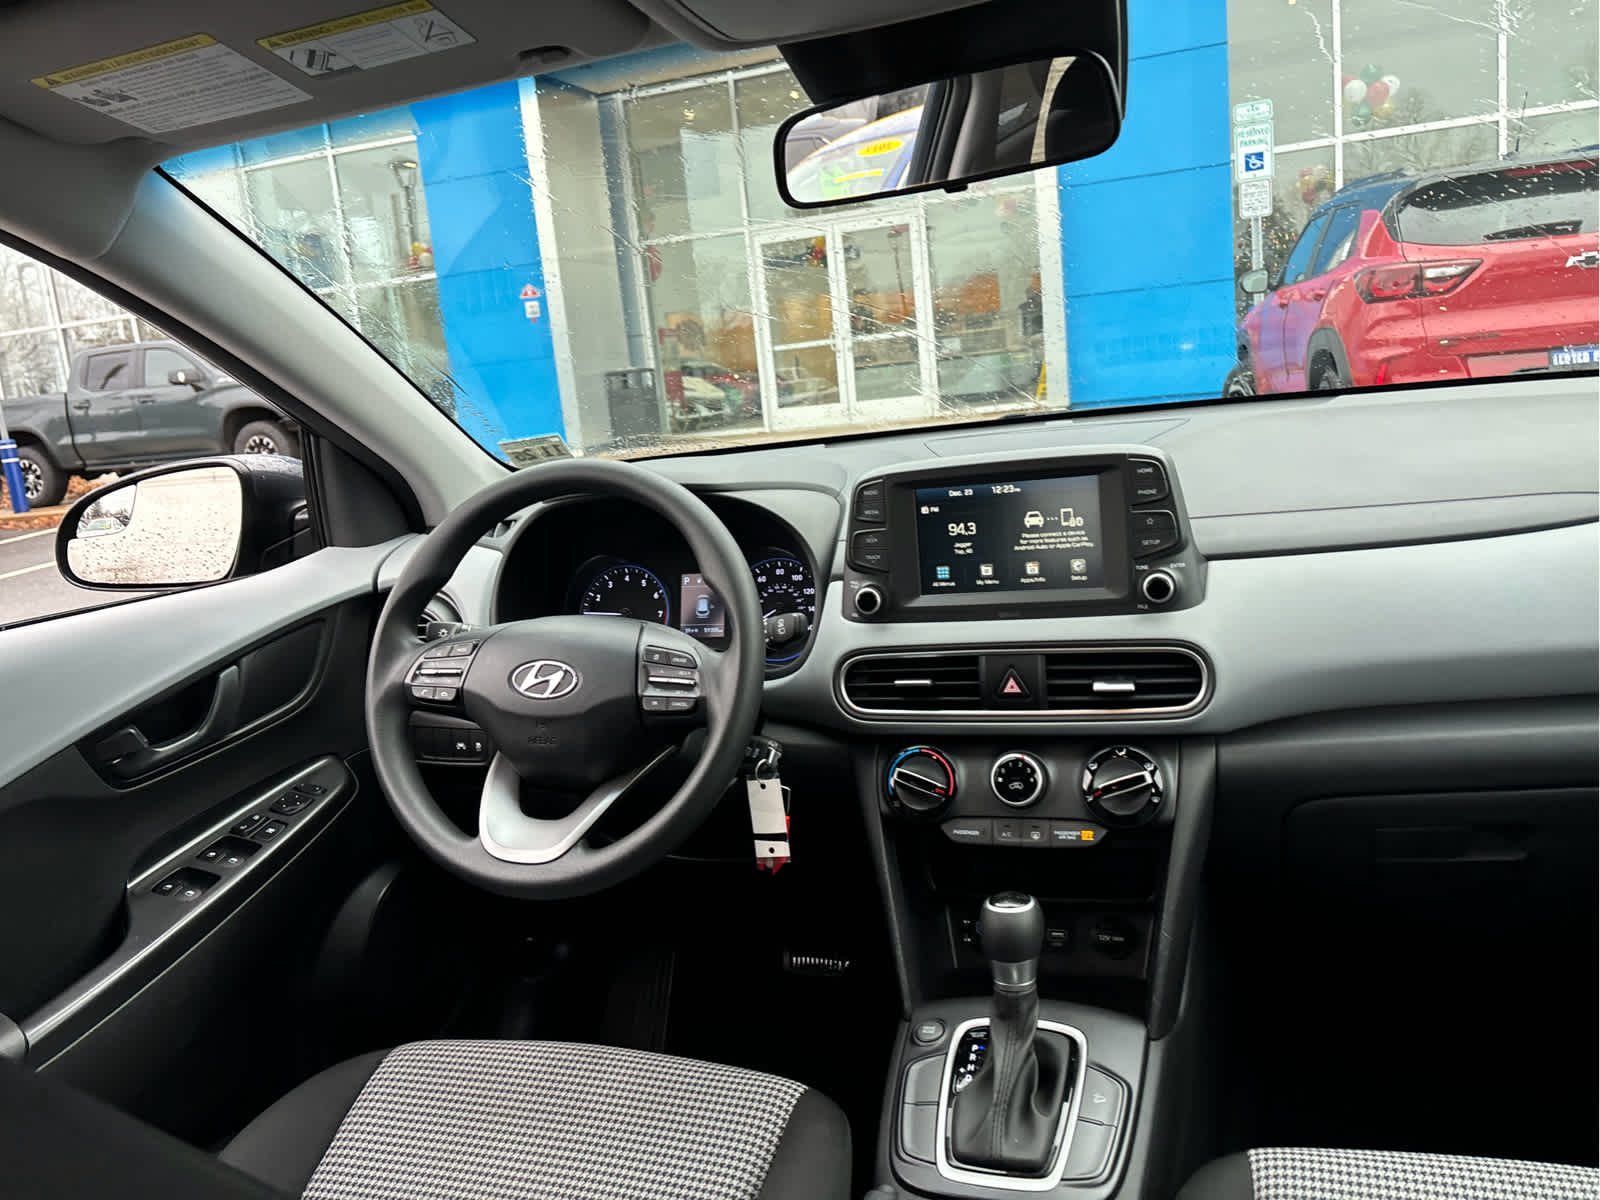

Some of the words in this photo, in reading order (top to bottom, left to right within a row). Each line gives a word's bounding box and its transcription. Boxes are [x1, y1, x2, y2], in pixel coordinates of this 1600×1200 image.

[947, 522, 977, 536] 94.3
[757, 575, 767, 583] 60
[803, 587, 815, 595] 120
[971, 1044, 979, 1052] P
[969, 1053, 976, 1061] R
